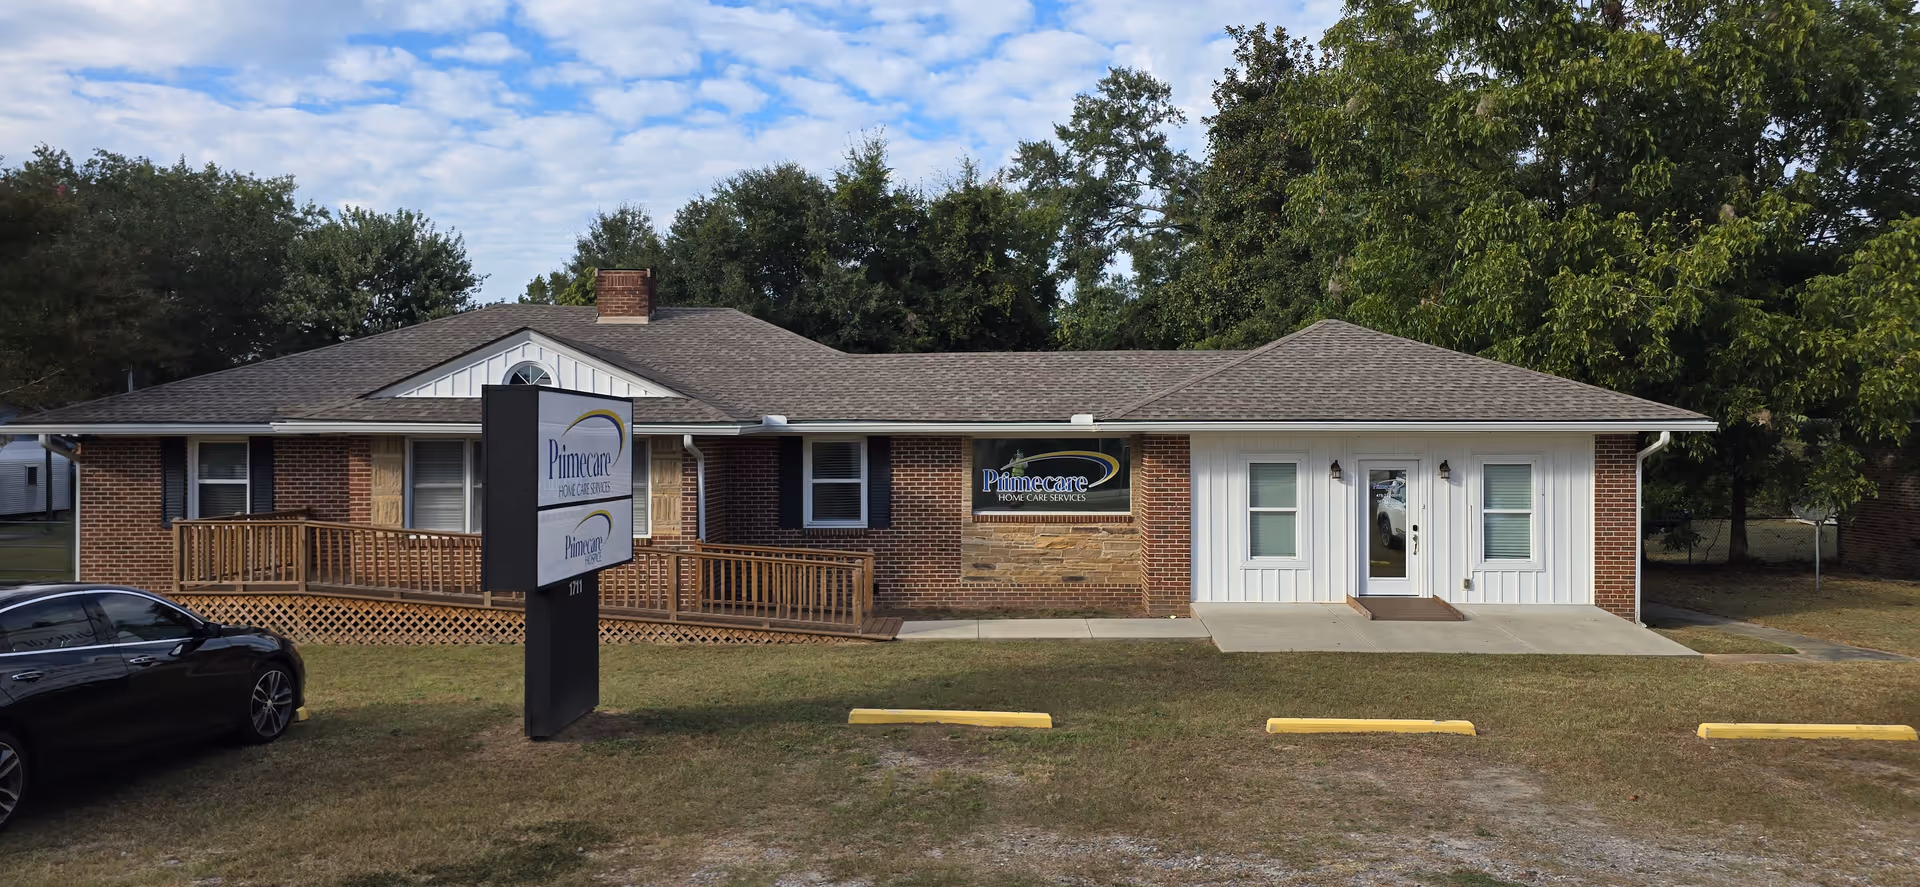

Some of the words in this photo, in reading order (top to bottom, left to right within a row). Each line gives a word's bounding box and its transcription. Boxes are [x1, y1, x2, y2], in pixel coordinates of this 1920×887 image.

[548, 438, 611, 480] Primecare
[558, 483, 575, 498] HOME
[576, 482, 590, 497] CARE
[590, 480, 611, 496] SERVICES
[982, 468, 1088, 493] Primecare
[998, 493, 1024, 502] HOME
[1026, 493, 1048, 502] CARE
[1049, 493, 1086, 502] SERVICES
[568, 578, 583, 596] 1711
